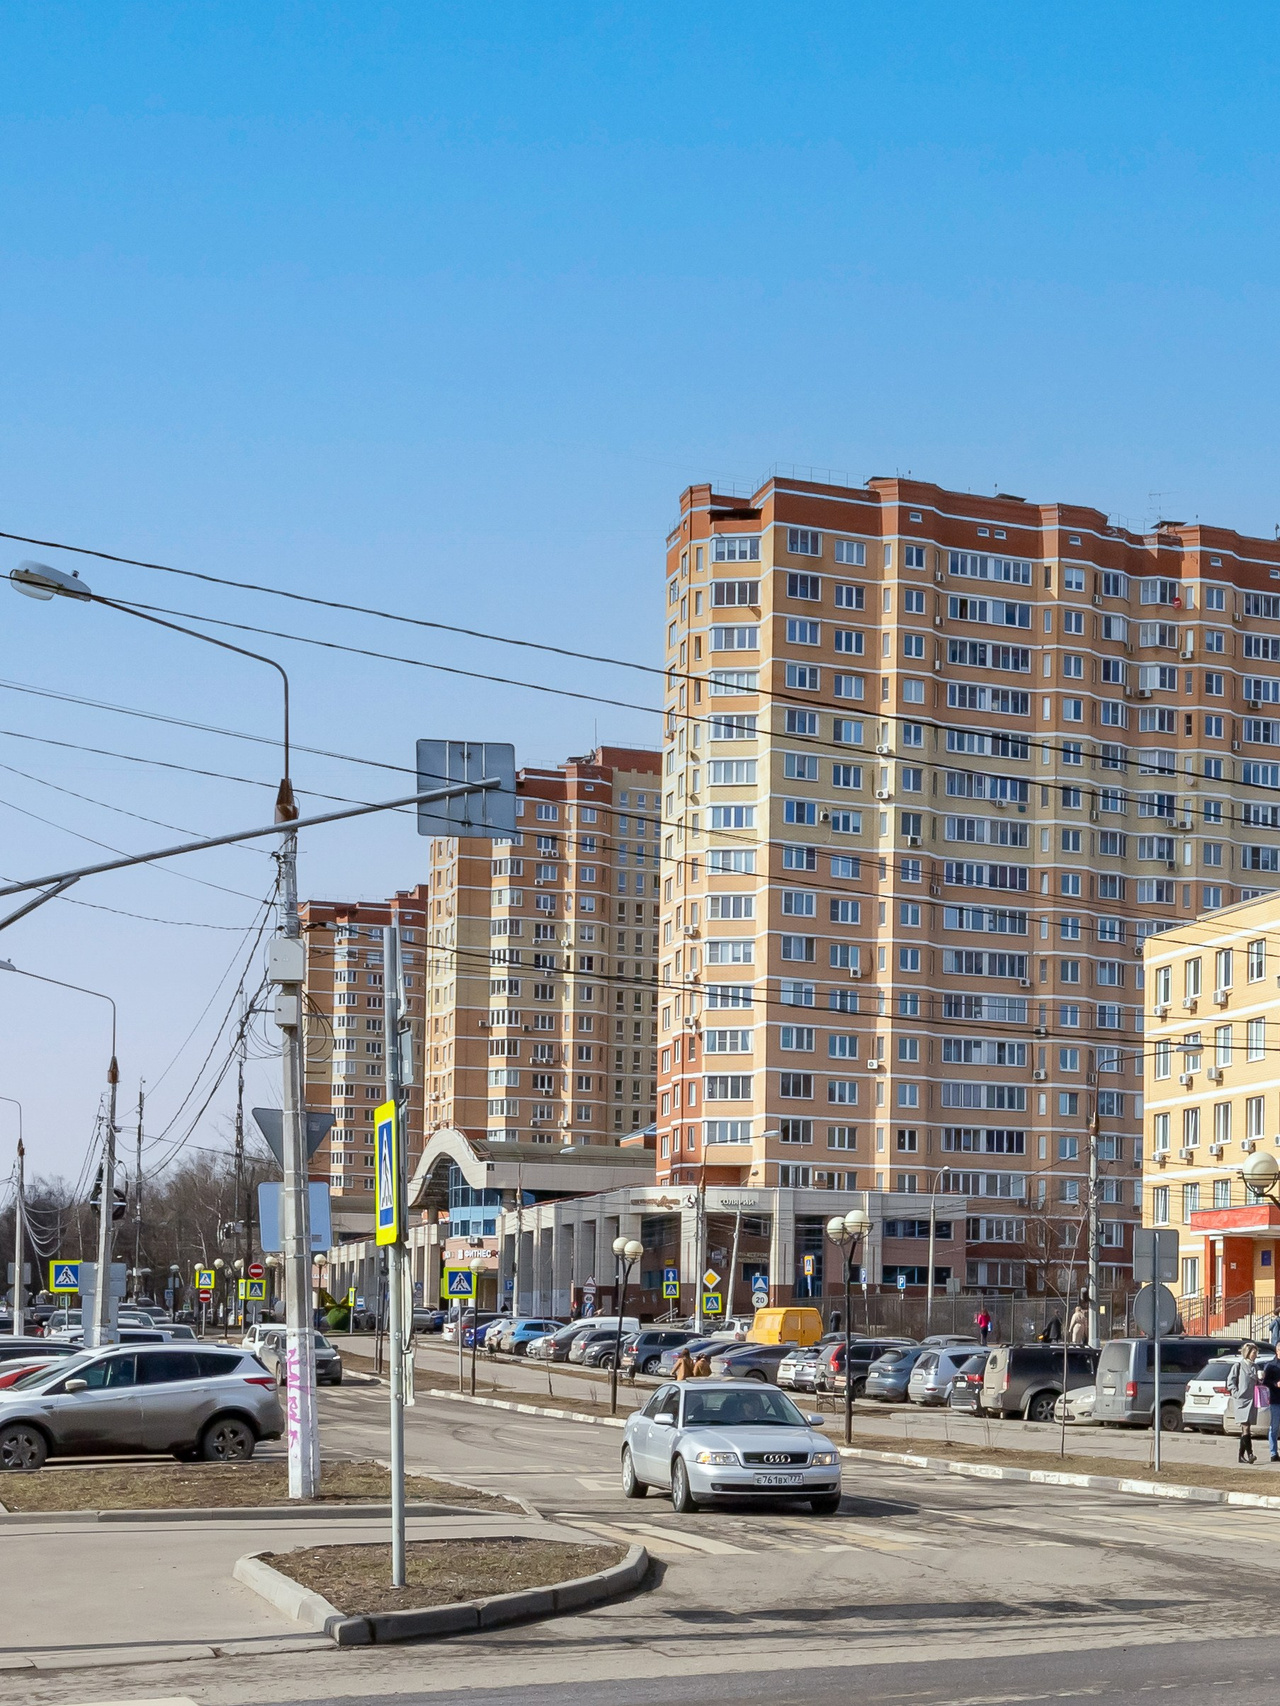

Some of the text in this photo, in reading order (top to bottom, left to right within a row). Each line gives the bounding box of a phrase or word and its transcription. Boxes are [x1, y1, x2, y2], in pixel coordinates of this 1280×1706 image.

[464, 1249, 492, 1259] ФИТНЕС
[507, 1281, 513, 1291] P
[899, 1277, 905, 1288] P
[755, 1296, 765, 1304] 20
